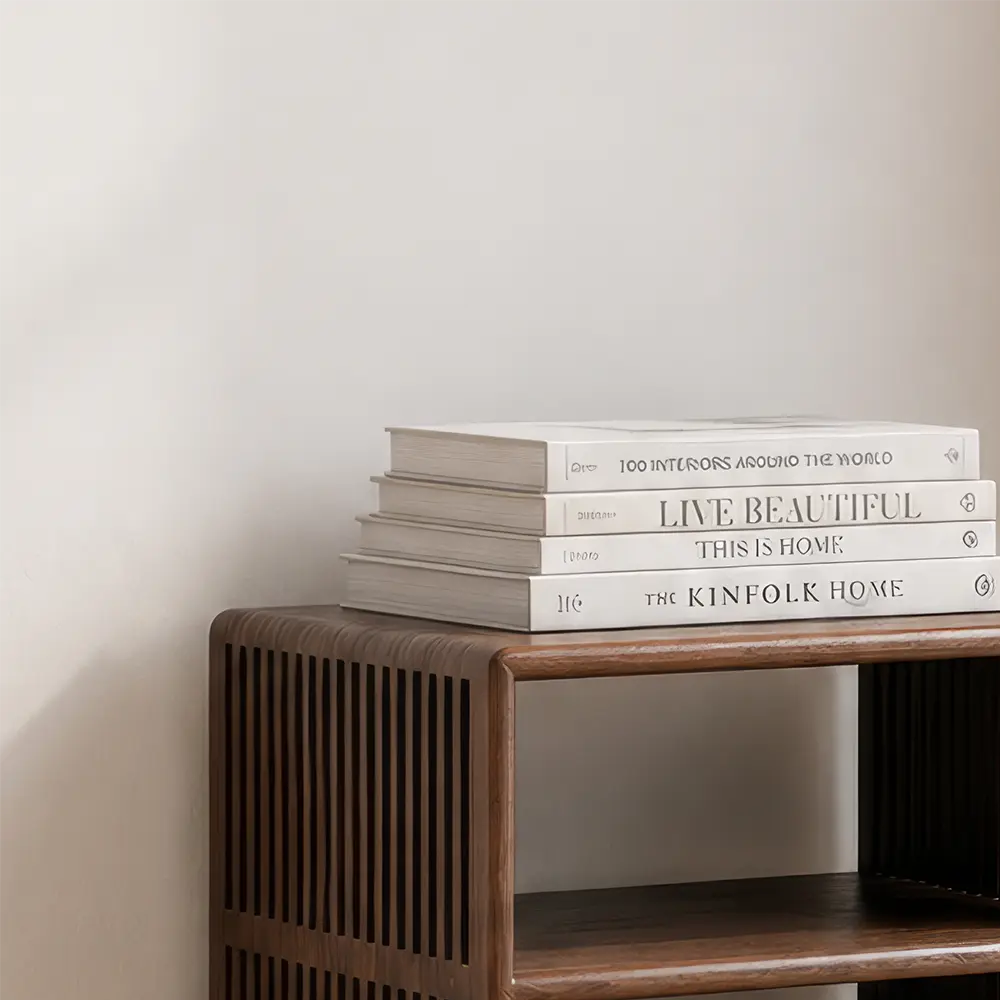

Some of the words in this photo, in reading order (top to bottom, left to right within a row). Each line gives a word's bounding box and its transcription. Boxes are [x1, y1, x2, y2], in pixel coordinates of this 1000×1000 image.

[620, 459, 648, 473] 100
[659, 497, 734, 527] LIVE
[744, 492, 922, 525] BEAUTIFUL
[755, 537, 774, 558] IS
[688, 581, 820, 607] KINFOLK
